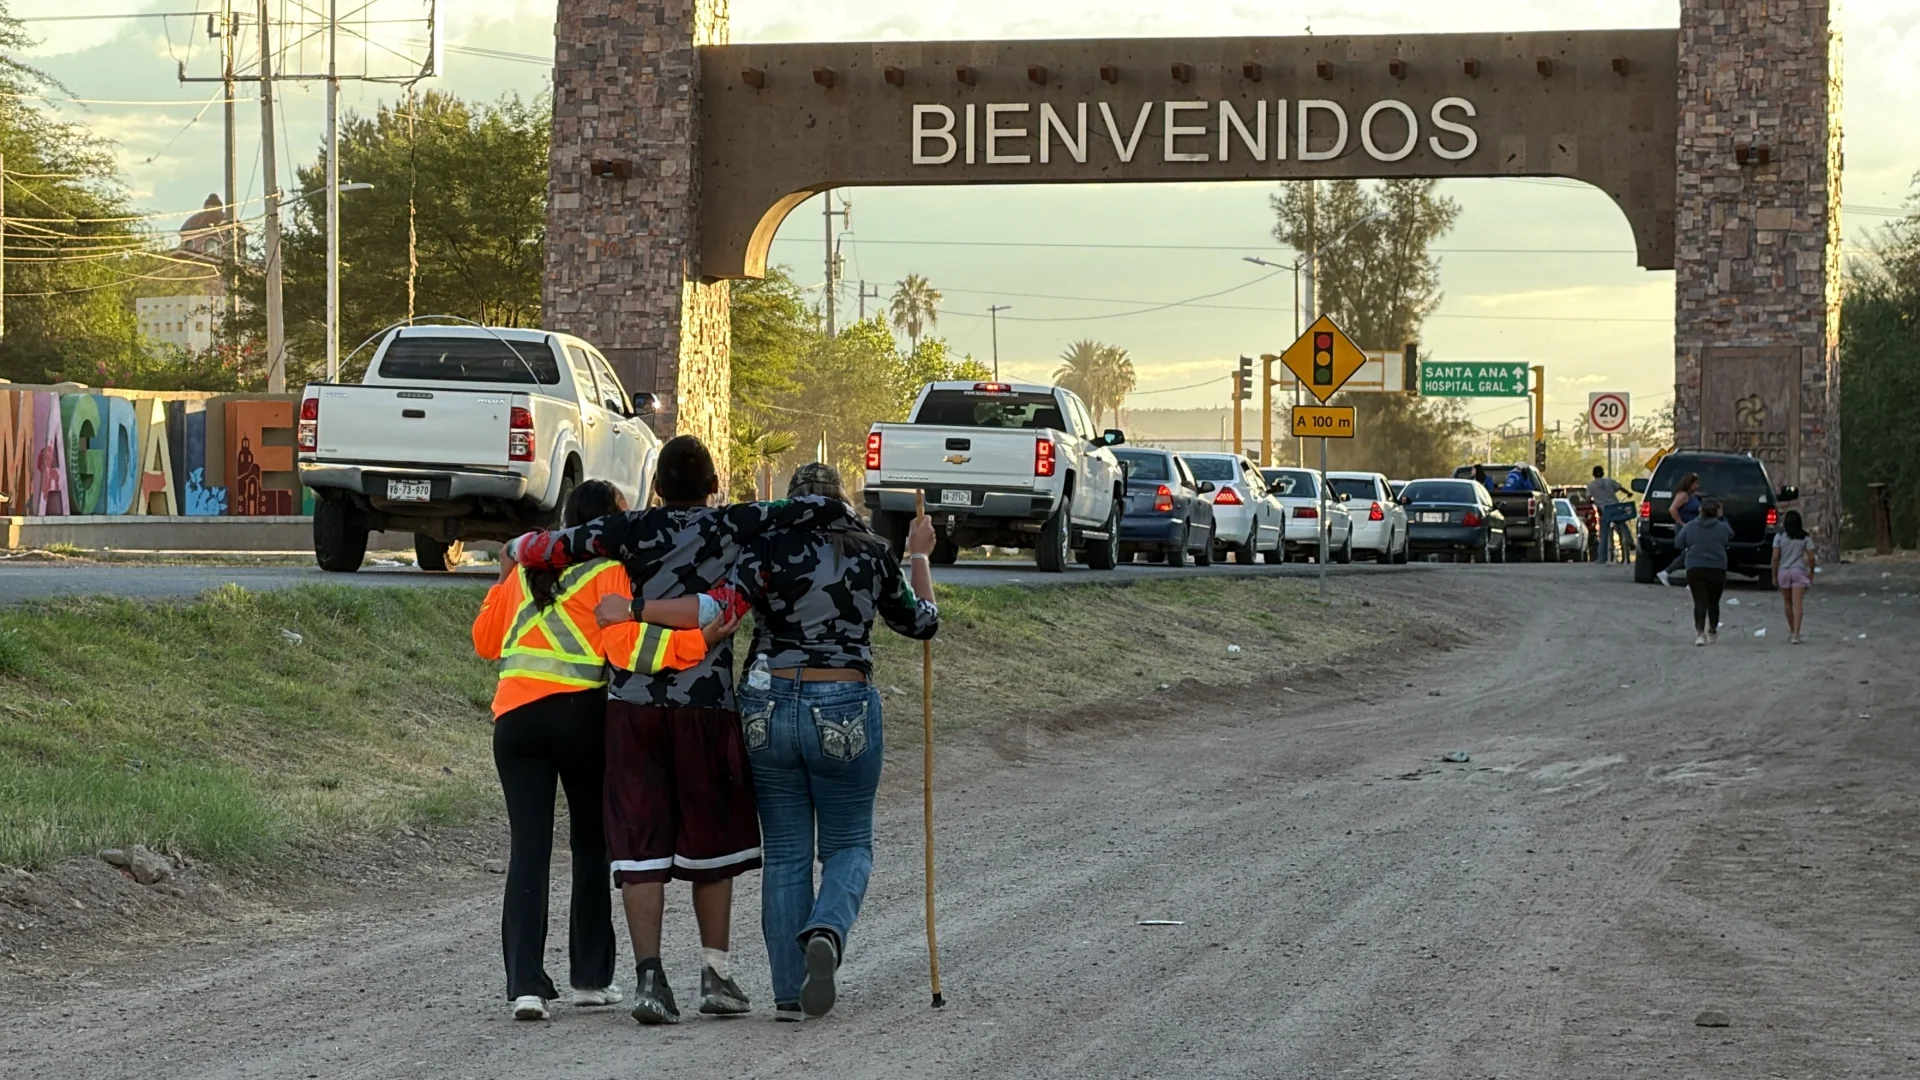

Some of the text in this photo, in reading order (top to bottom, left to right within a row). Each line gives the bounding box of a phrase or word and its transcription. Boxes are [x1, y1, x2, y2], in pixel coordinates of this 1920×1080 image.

[912, 97, 1478, 165] BIENVENIDOS
[1425, 366, 1508, 378] SANTA ANA
[1425, 381, 1509, 393] HOSPITAL GRAL.
[1599, 402, 1619, 418] 20
[1296, 416, 1350, 428] A 100 m
[0, 390, 314, 516] MAGDALE
